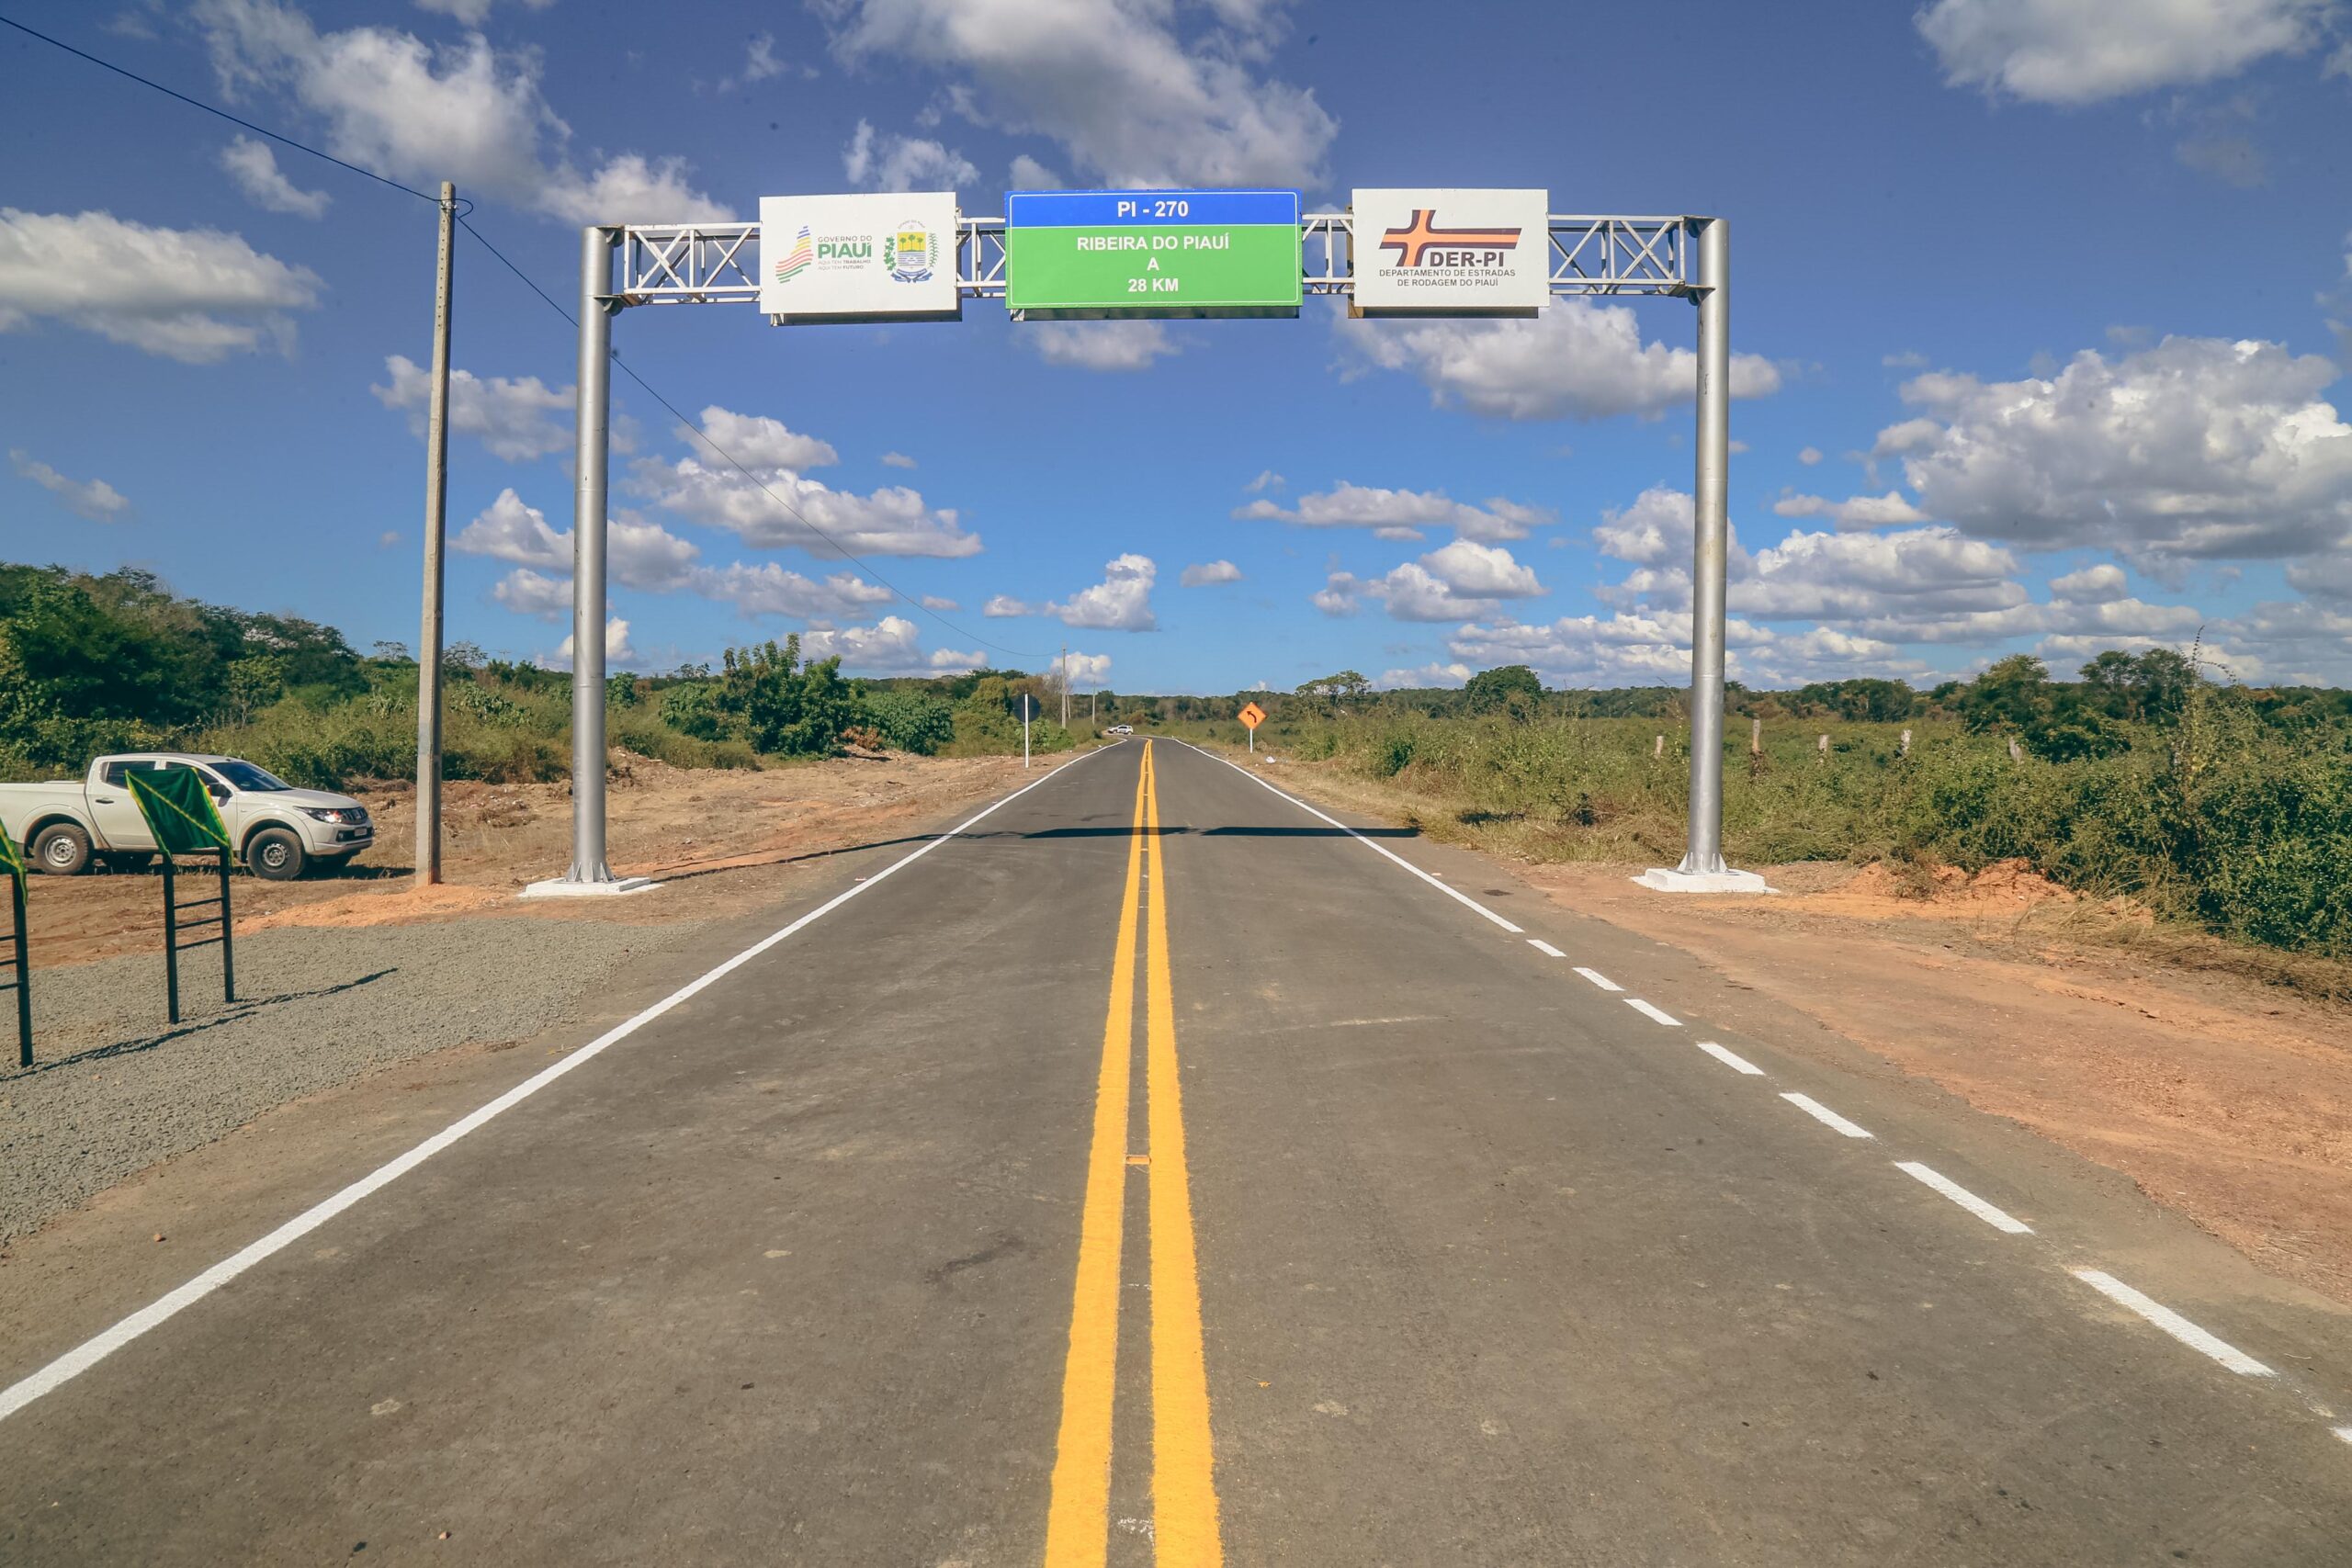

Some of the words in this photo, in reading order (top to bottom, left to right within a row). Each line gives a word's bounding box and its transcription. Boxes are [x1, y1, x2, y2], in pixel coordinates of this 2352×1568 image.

[1117, 201, 1136, 217] PI
[1154, 200, 1189, 217] 270
[1077, 236, 1148, 251] RIBEIRA
[1152, 235, 1178, 250] DO
[1183, 232, 1229, 250] PIAUÍ
[1147, 257, 1159, 271] A
[1430, 252, 1504, 267] DER-PI
[1128, 278, 1147, 292] 28
[1153, 278, 1179, 292] KM
[1411, 278, 1457, 287] RODAGEM
